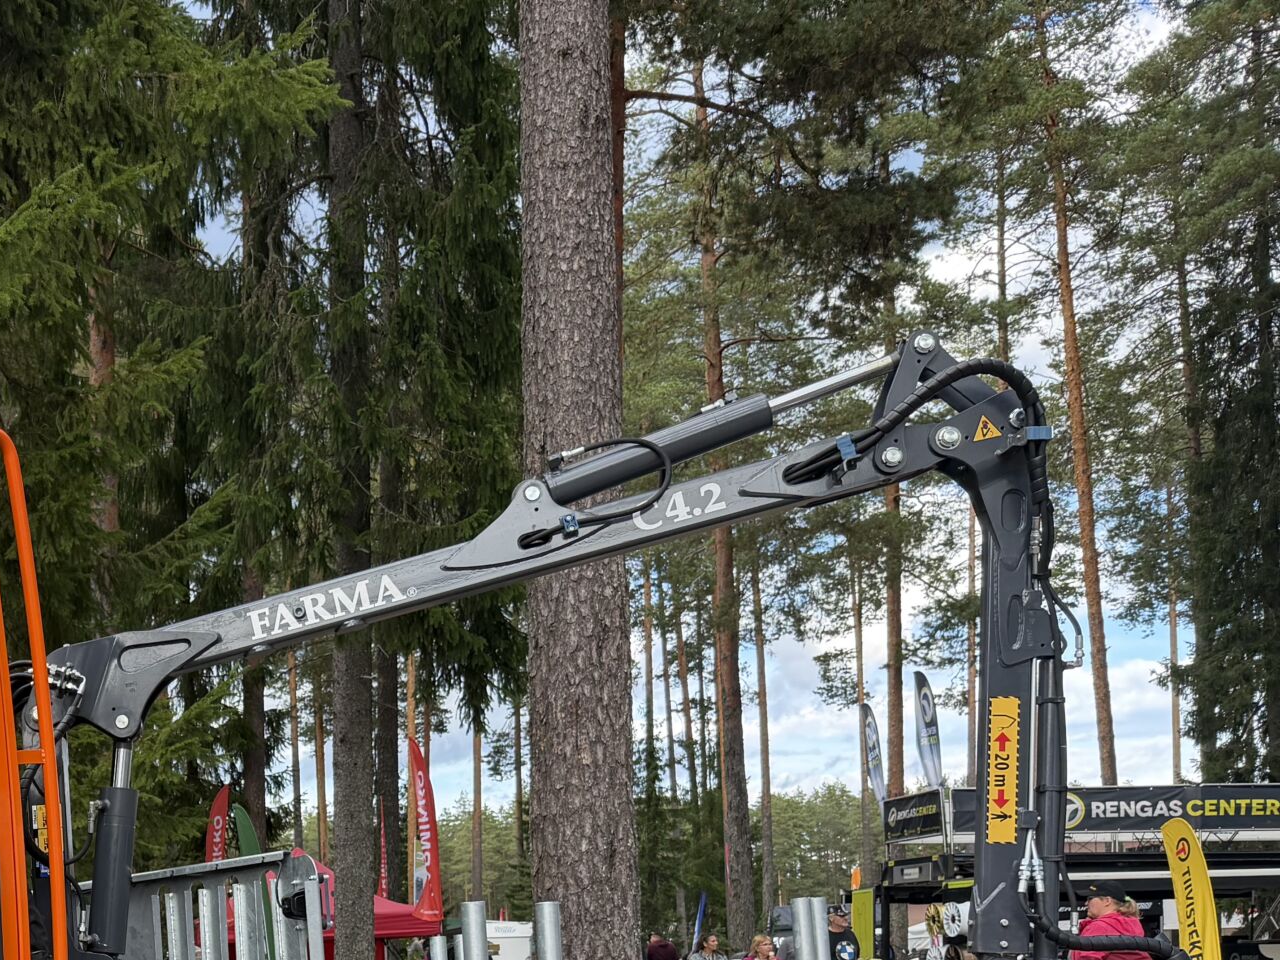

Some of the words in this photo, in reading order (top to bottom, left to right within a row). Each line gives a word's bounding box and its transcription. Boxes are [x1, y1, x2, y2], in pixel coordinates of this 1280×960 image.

[246, 574, 407, 640] FARMA
[995, 753, 1010, 771] 20
[994, 774, 1006, 787] m
[1091, 800, 1183, 818] RENGAS
[1186, 799, 1280, 817] CENTER
